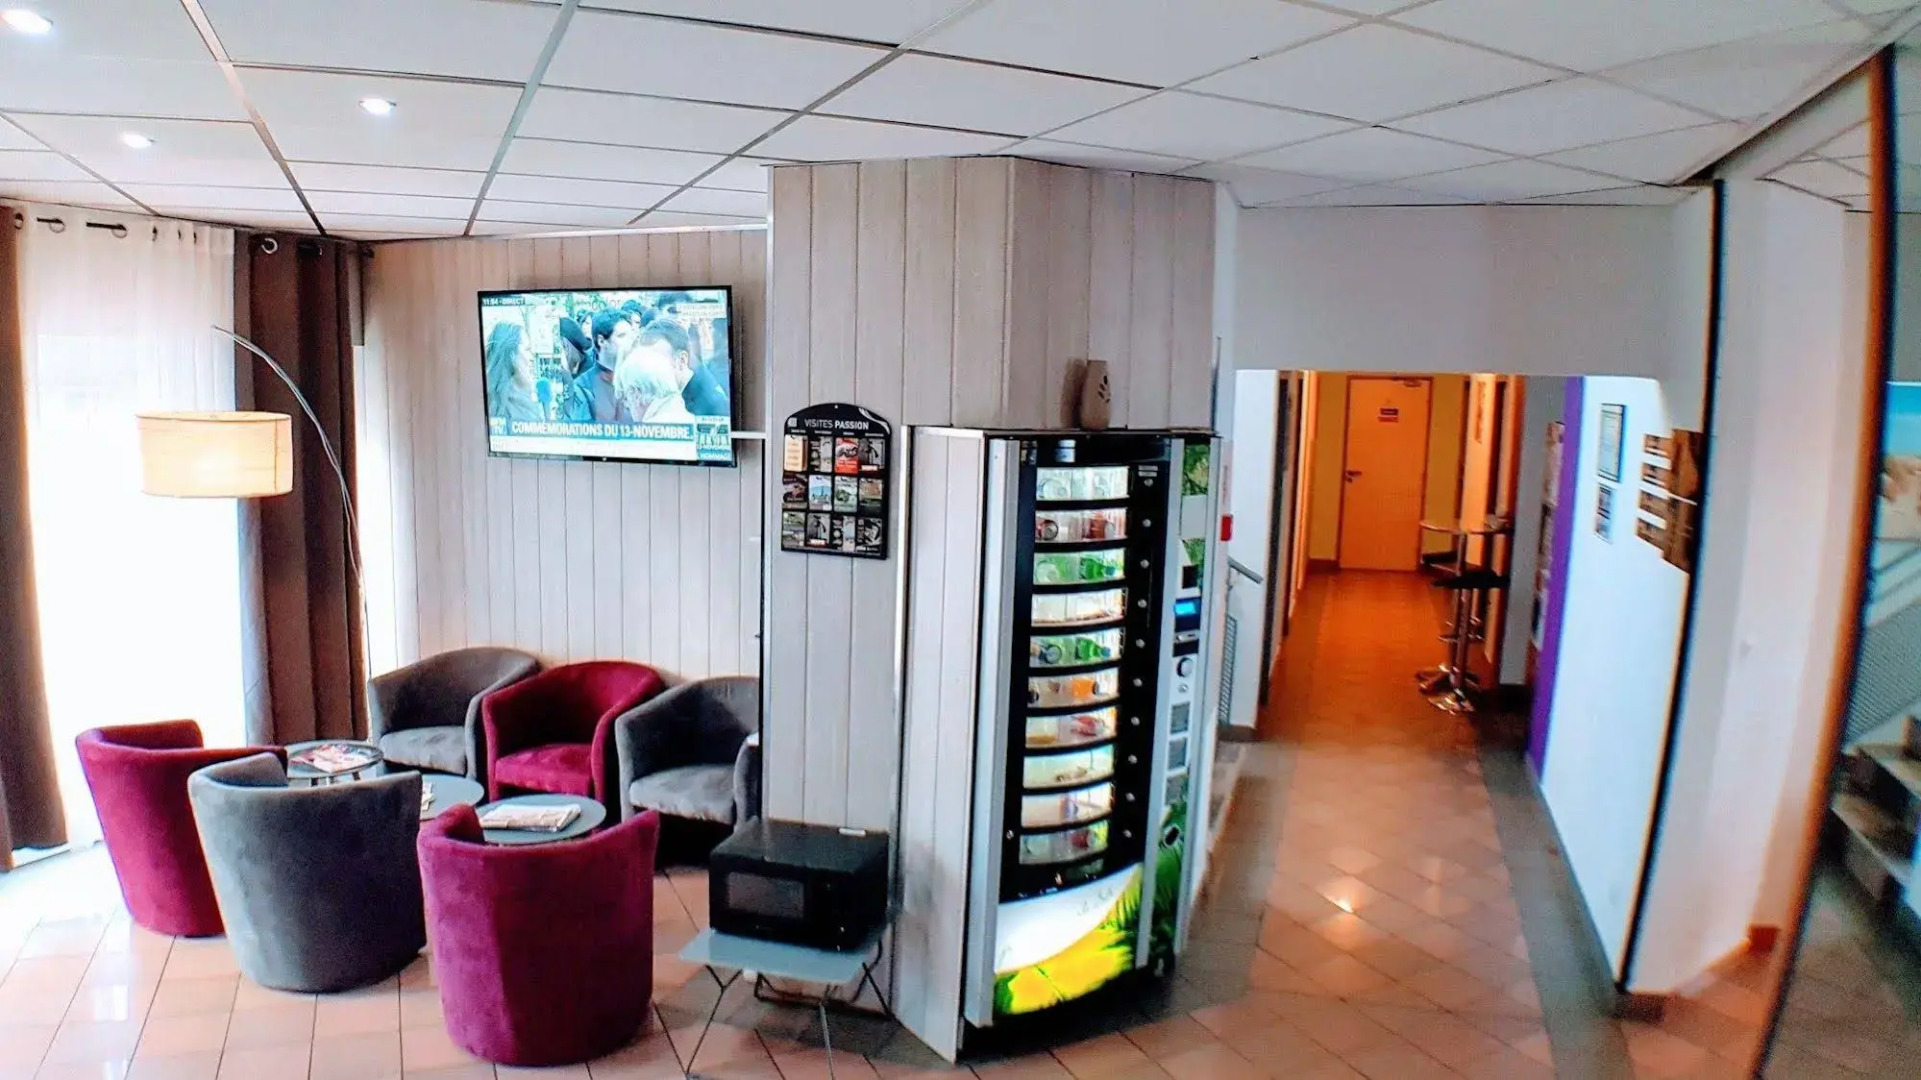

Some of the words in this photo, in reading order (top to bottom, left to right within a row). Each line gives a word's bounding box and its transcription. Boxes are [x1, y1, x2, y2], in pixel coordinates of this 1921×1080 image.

[604, 423, 618, 437] DU
[804, 418, 833, 428] VISITES
[834, 420, 869, 430] PASSION
